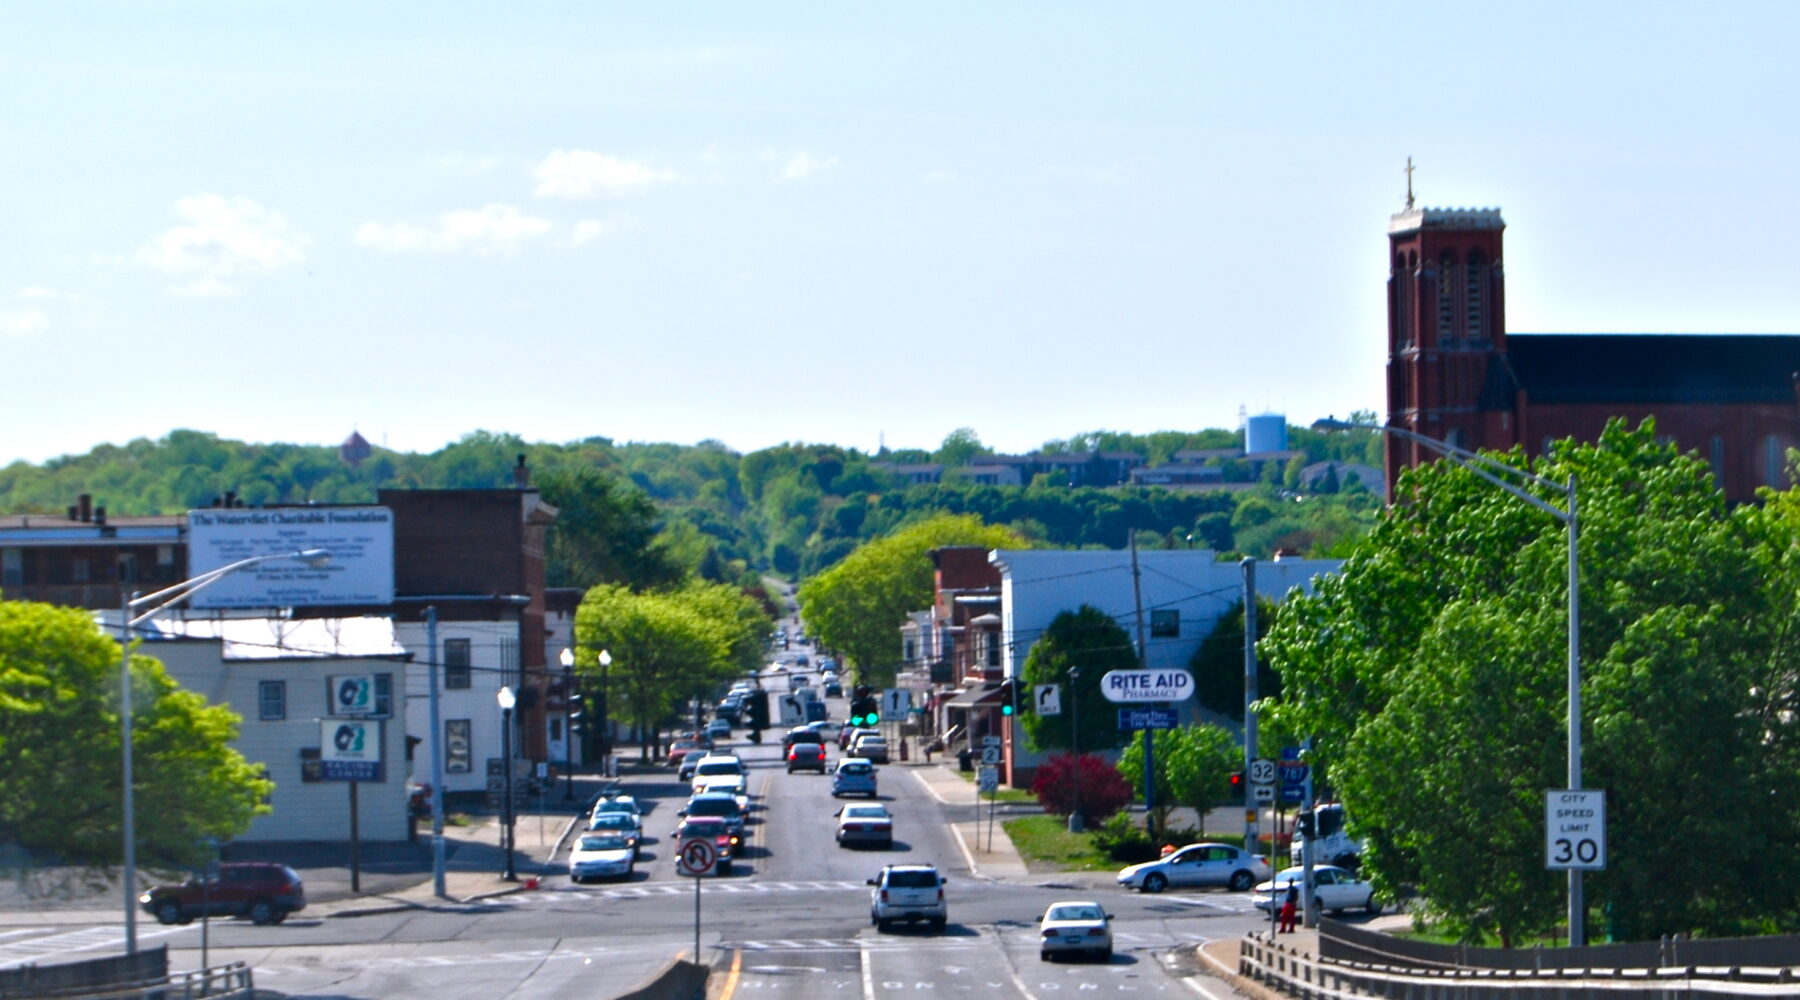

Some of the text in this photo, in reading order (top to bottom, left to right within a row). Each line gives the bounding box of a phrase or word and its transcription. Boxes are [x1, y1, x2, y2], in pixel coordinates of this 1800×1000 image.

[328, 511, 388, 523] Foundation
[1110, 673, 1187, 689] RITE AID
[1123, 687, 1177, 699] PHARMACY
[986, 749, 994, 761] 2
[1253, 764, 1273, 778] 32
[1284, 767, 1304, 780] 787
[1561, 794, 1587, 803] CITY
[1556, 808, 1594, 818] SPEED
[1560, 823, 1590, 833] LIMIT
[1554, 838, 1598, 864] 30
